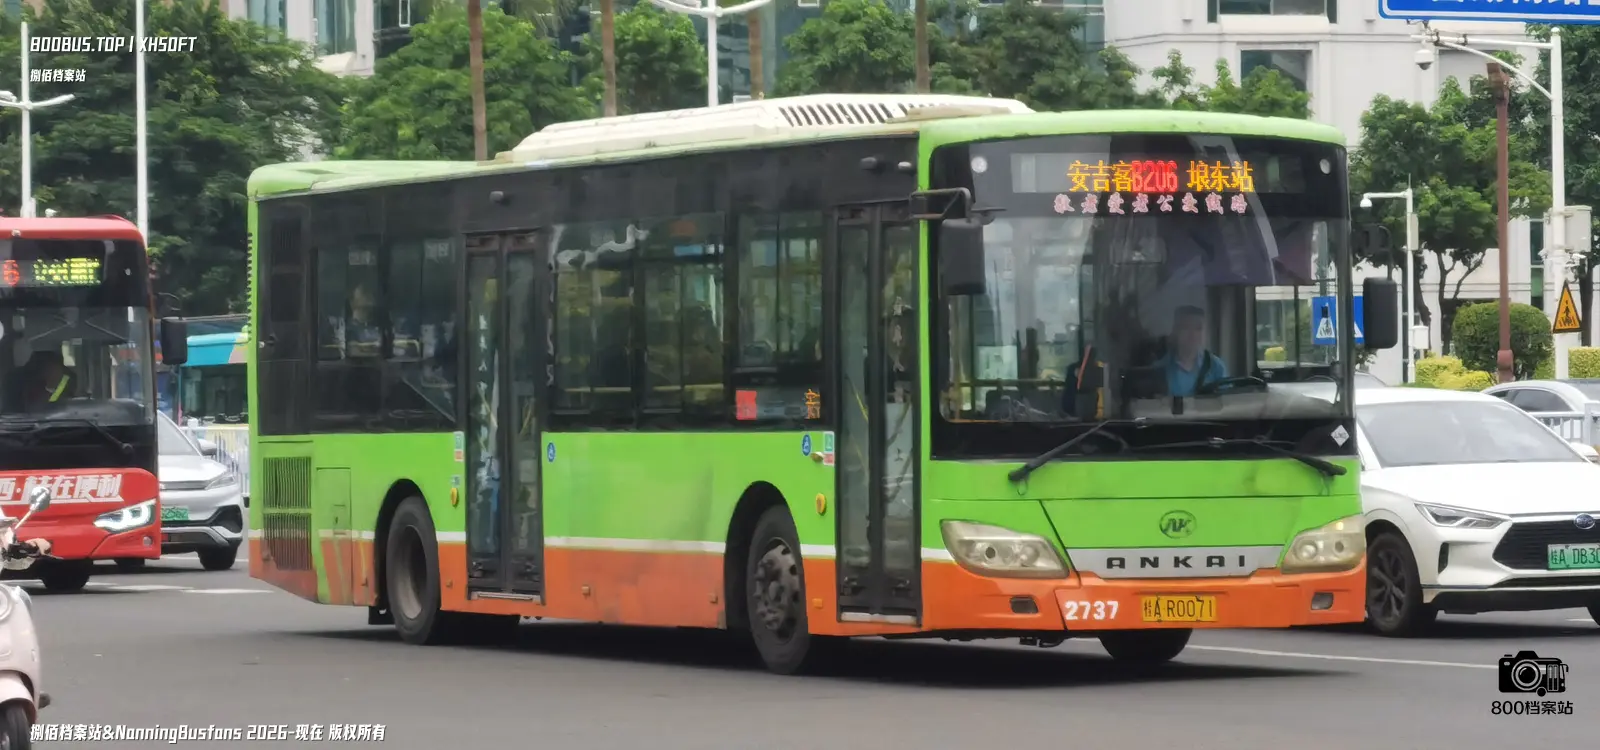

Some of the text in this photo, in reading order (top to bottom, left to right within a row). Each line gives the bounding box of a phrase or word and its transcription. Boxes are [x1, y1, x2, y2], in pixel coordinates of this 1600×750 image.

[1186, 160, 1254, 192] 埌东站
[1106, 555, 1246, 569] ANKAI
[1065, 601, 1119, 620] 2737
